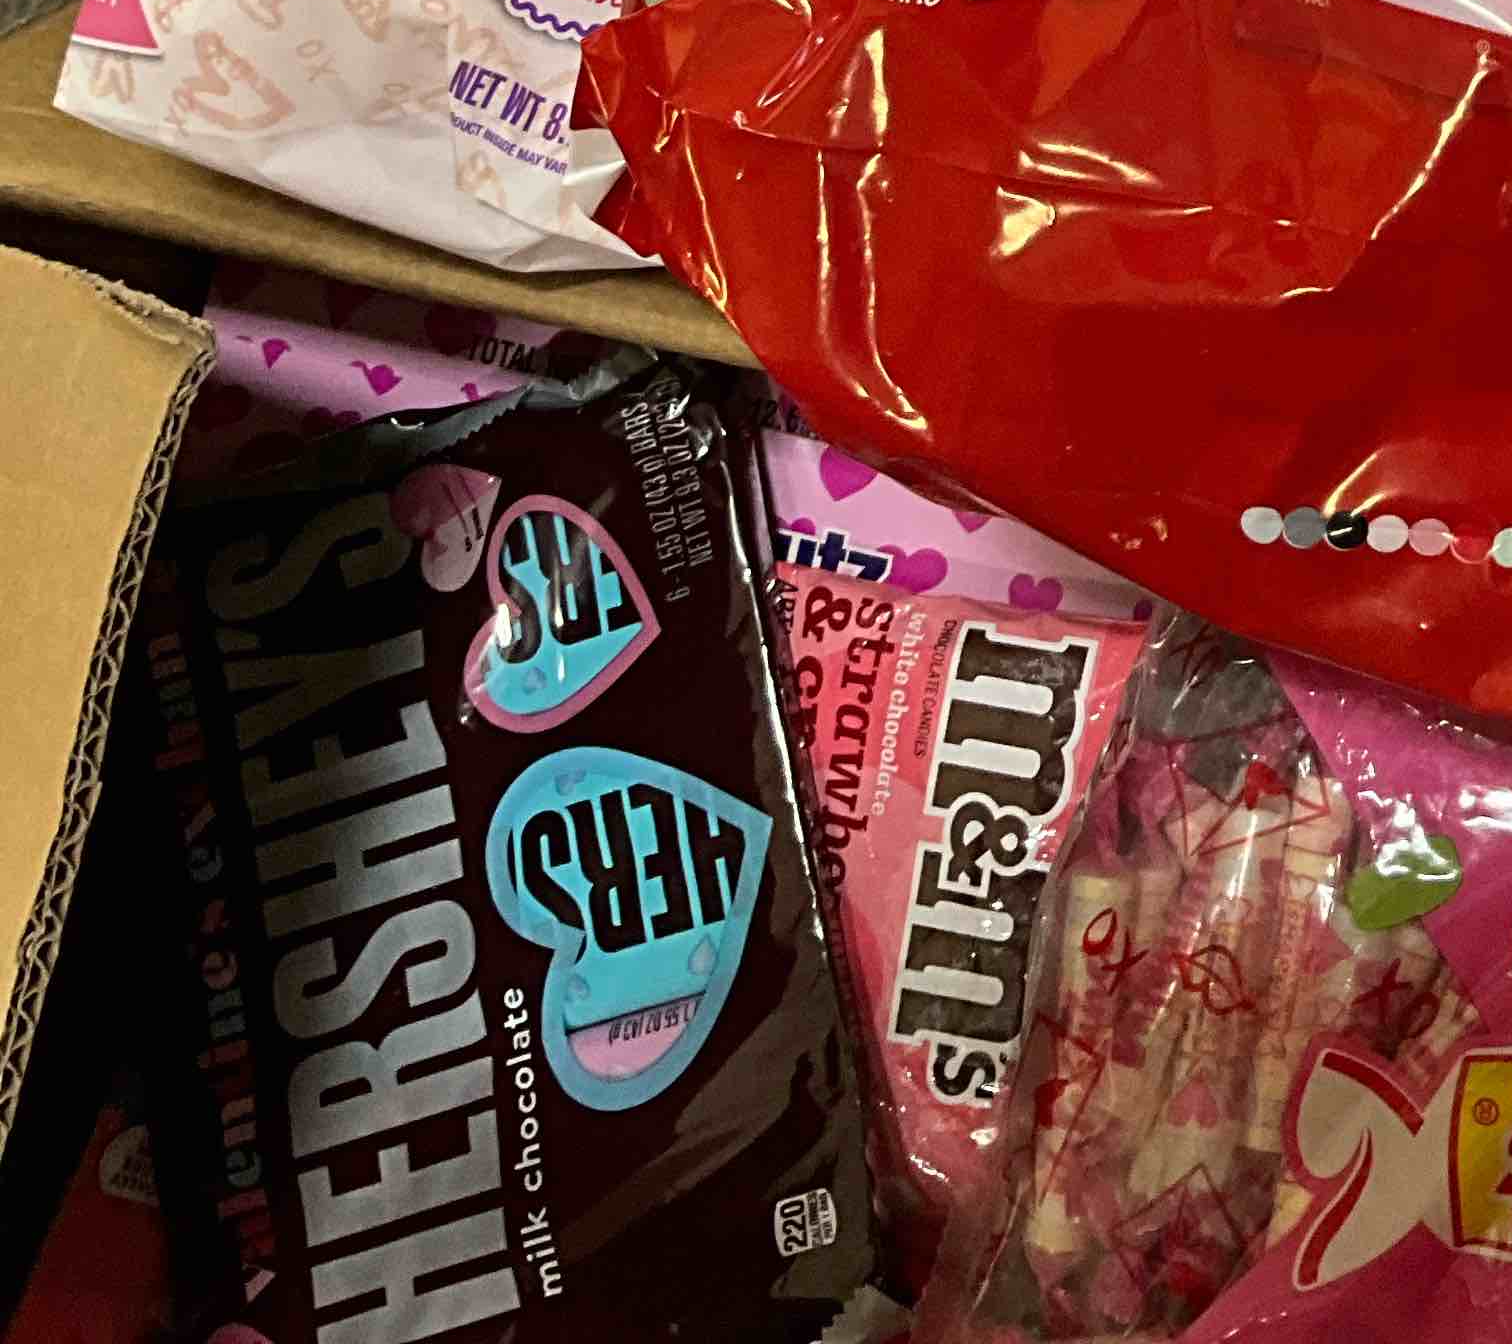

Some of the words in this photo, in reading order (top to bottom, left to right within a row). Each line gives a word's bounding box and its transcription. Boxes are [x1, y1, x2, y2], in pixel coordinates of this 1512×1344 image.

[449, 60, 507, 110] NET
[499, 81, 547, 133] WT
[482, 128, 518, 158] INSIDE
[517, 147, 544, 168] MAY
[622, 402, 658, 454] BARS
[679, 498, 707, 530] WT
[686, 531, 714, 567] NET
[892, 611, 928, 682] white
[925, 619, 957, 696] CHOCOLATE
[819, 598, 896, 892] strawbe
[872, 684, 911, 816] chocolate
[914, 694, 935, 758] CANDIES
[521, 784, 746, 952] HERS
[206, 491, 522, 1344] HERSHEY'S
[504, 986, 544, 1191] chocolate
[522, 1206, 564, 1298] milk
[780, 1200, 807, 1252] 220
